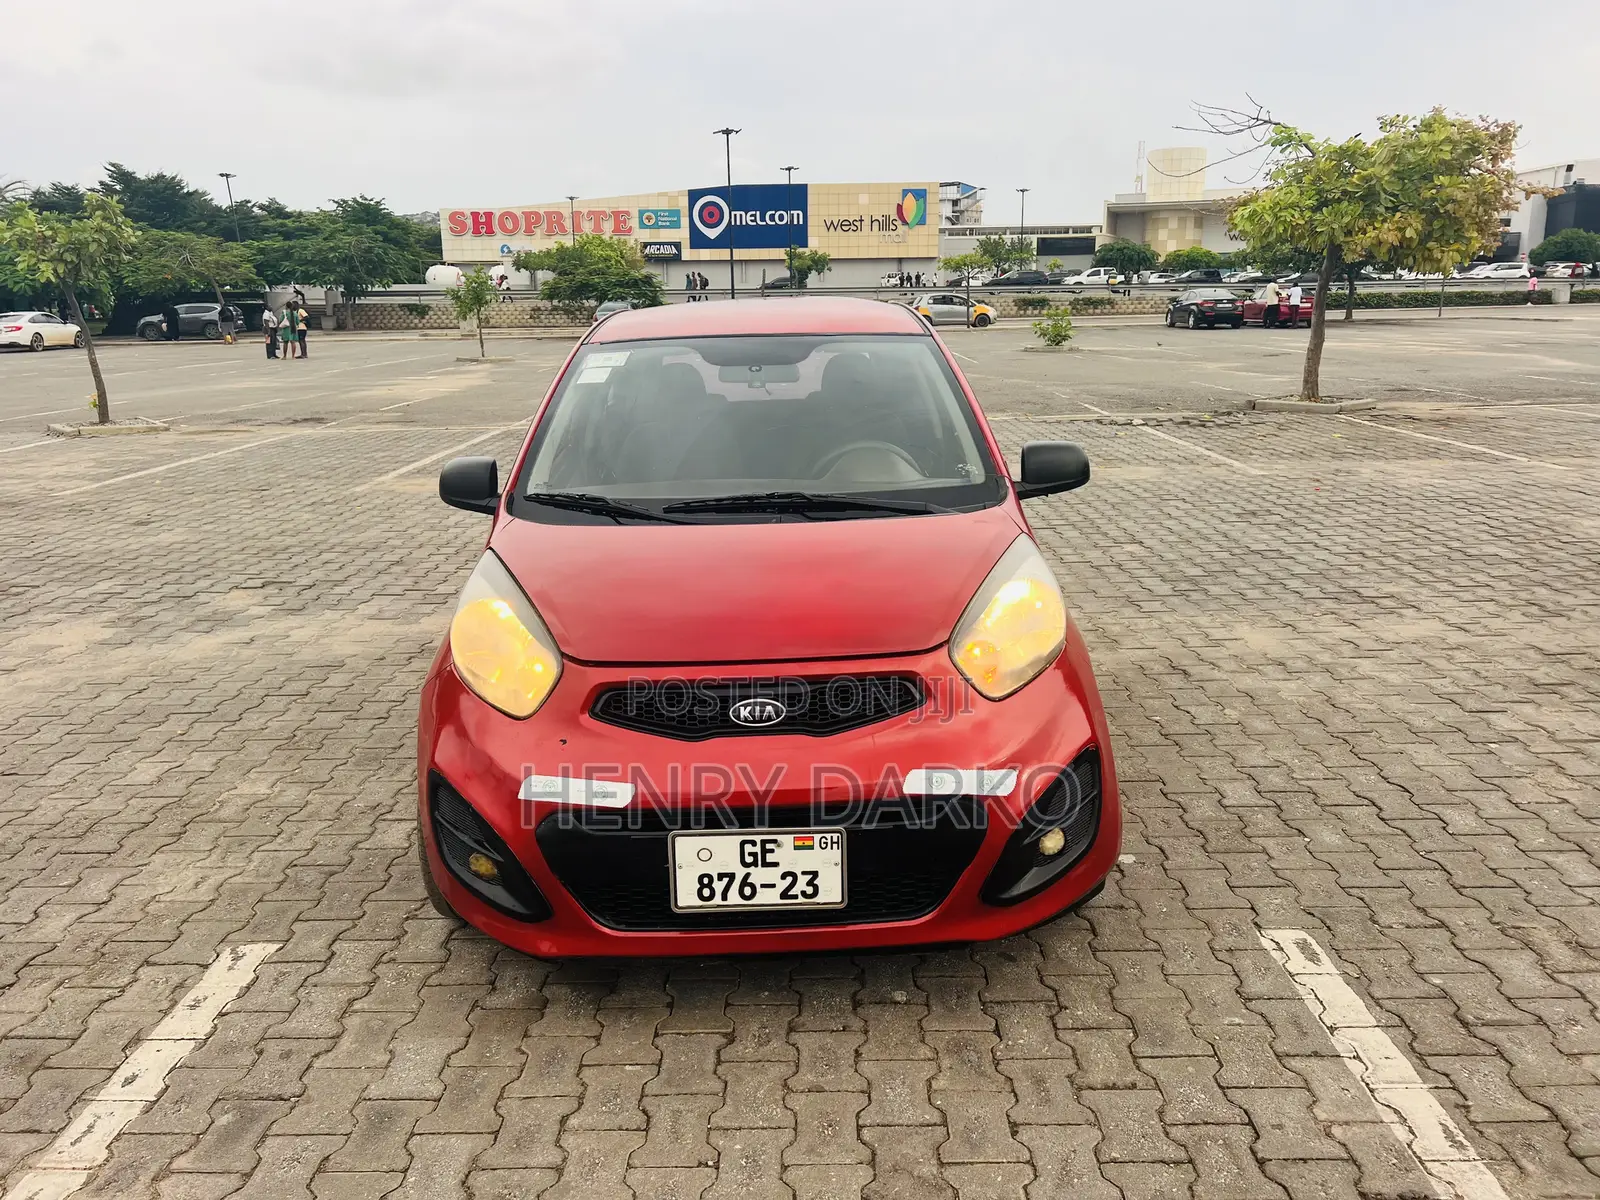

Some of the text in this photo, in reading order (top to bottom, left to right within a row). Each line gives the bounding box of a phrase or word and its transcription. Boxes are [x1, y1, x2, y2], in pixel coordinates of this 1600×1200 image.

[447, 210, 634, 237] SHOPRITE
[731, 210, 804, 226] MELCOM
[823, 214, 899, 232] west hills
[643, 244, 679, 255] ARCADIA
[739, 705, 777, 721] KIA
[818, 835, 841, 851] GH
[739, 838, 780, 868] GE
[696, 870, 820, 903] 876-23
